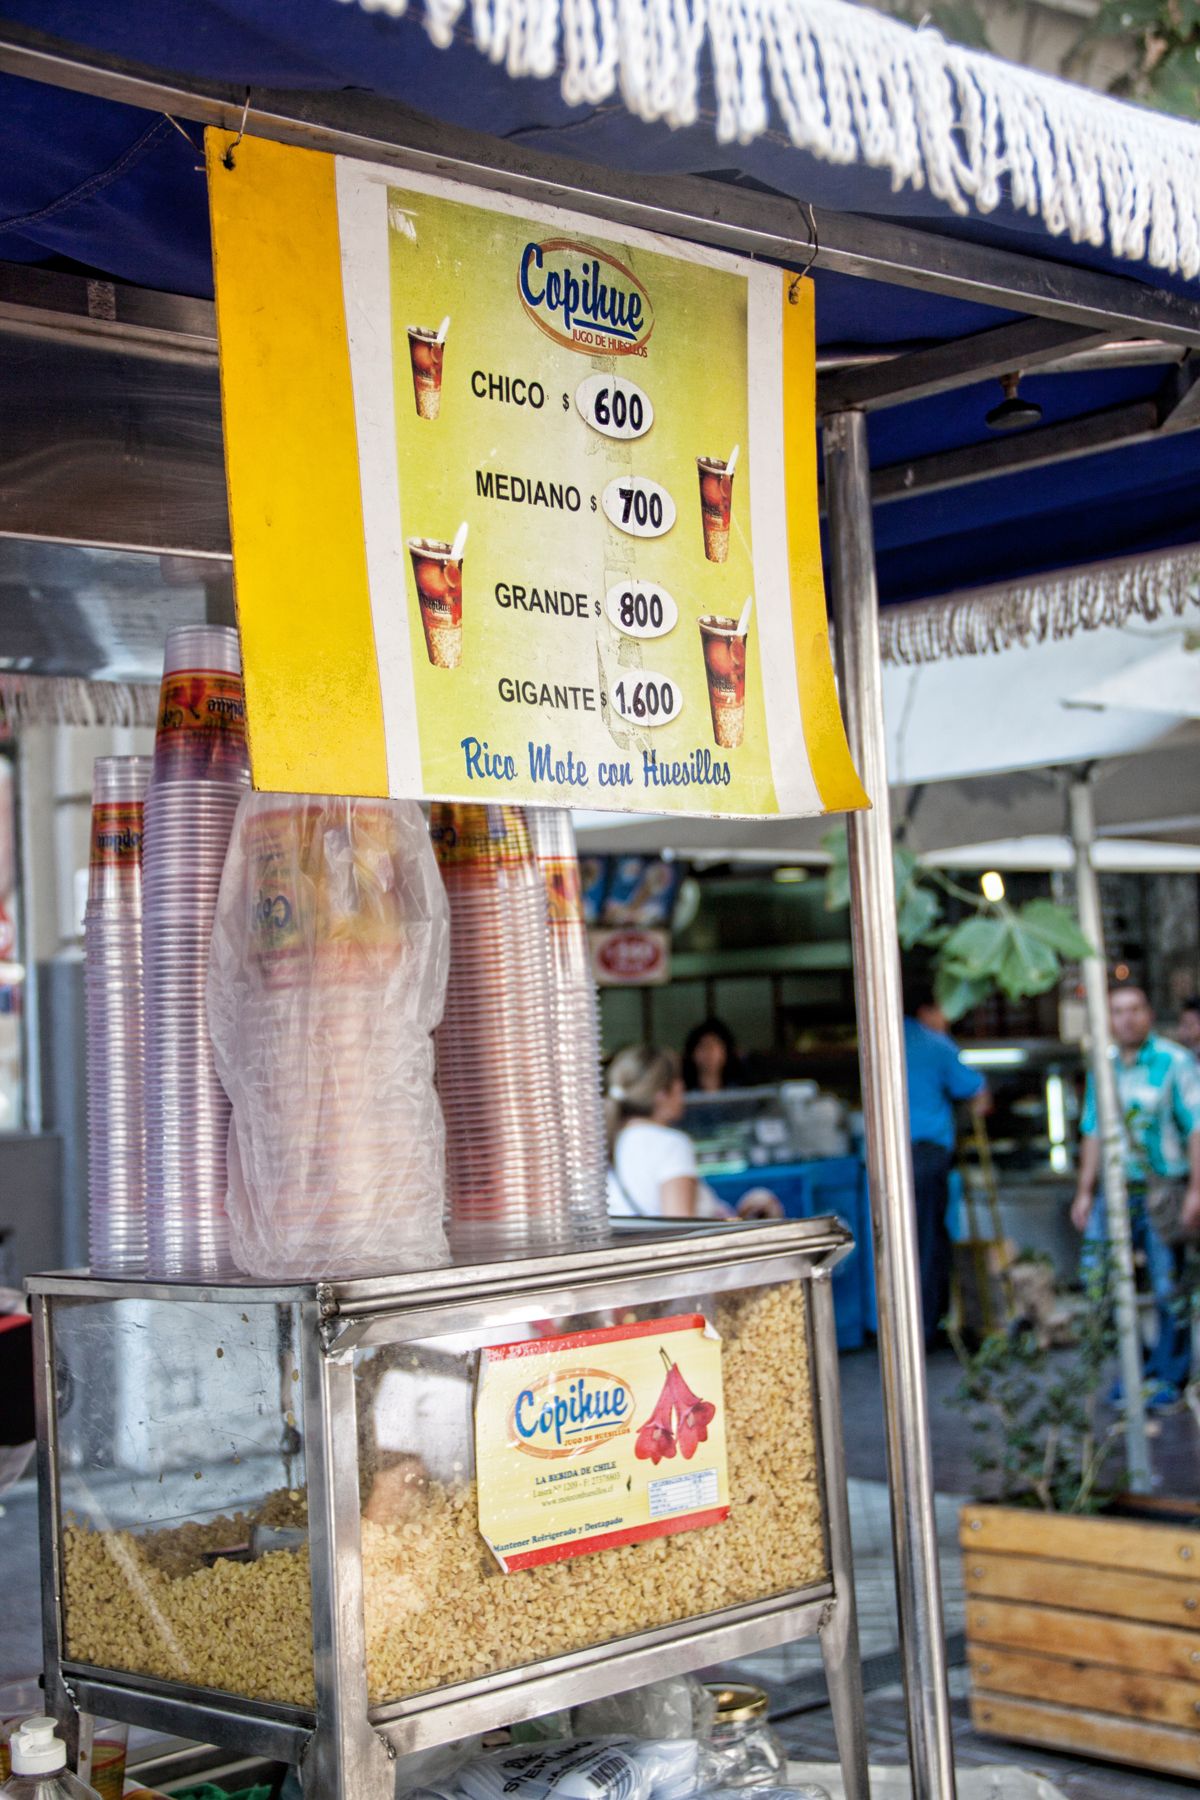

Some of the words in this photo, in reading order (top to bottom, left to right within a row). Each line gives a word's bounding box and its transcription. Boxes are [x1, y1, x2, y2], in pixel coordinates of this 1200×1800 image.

[519, 242, 644, 332] Copihue
[572, 329, 593, 344] JUGO
[595, 334, 606, 348] DE
[471, 370, 544, 409] CHICO
[562, 392, 570, 411] $
[594, 388, 643, 431] 600
[475, 469, 581, 513] MEDIANO
[590, 494, 598, 513] $
[618, 487, 663, 529] 700
[494, 582, 589, 619] GRANDE
[594, 599, 601, 617] $
[619, 591, 663, 628] 800
[498, 677, 596, 712] GIGANTE
[600, 691, 607, 708] $
[615, 680, 674, 718] 1.600
[461, 736, 518, 780] Rico
[528, 741, 589, 788] Mote
[599, 761, 634, 787] con
[643, 748, 731, 788] Huesillos
[514, 1378, 629, 1445] Copihue
[535, 1476, 546, 1485] LA
[548, 1469, 578, 1483] BEBIDA
[580, 1466, 591, 1476] DE
[593, 1460, 617, 1473] CHILE
[494, 1538, 530, 1552] Mantener
[531, 1527, 577, 1544] Refrigerado
[578, 1526, 583, 1534] y
[584, 1517, 624, 1532] Destapado
